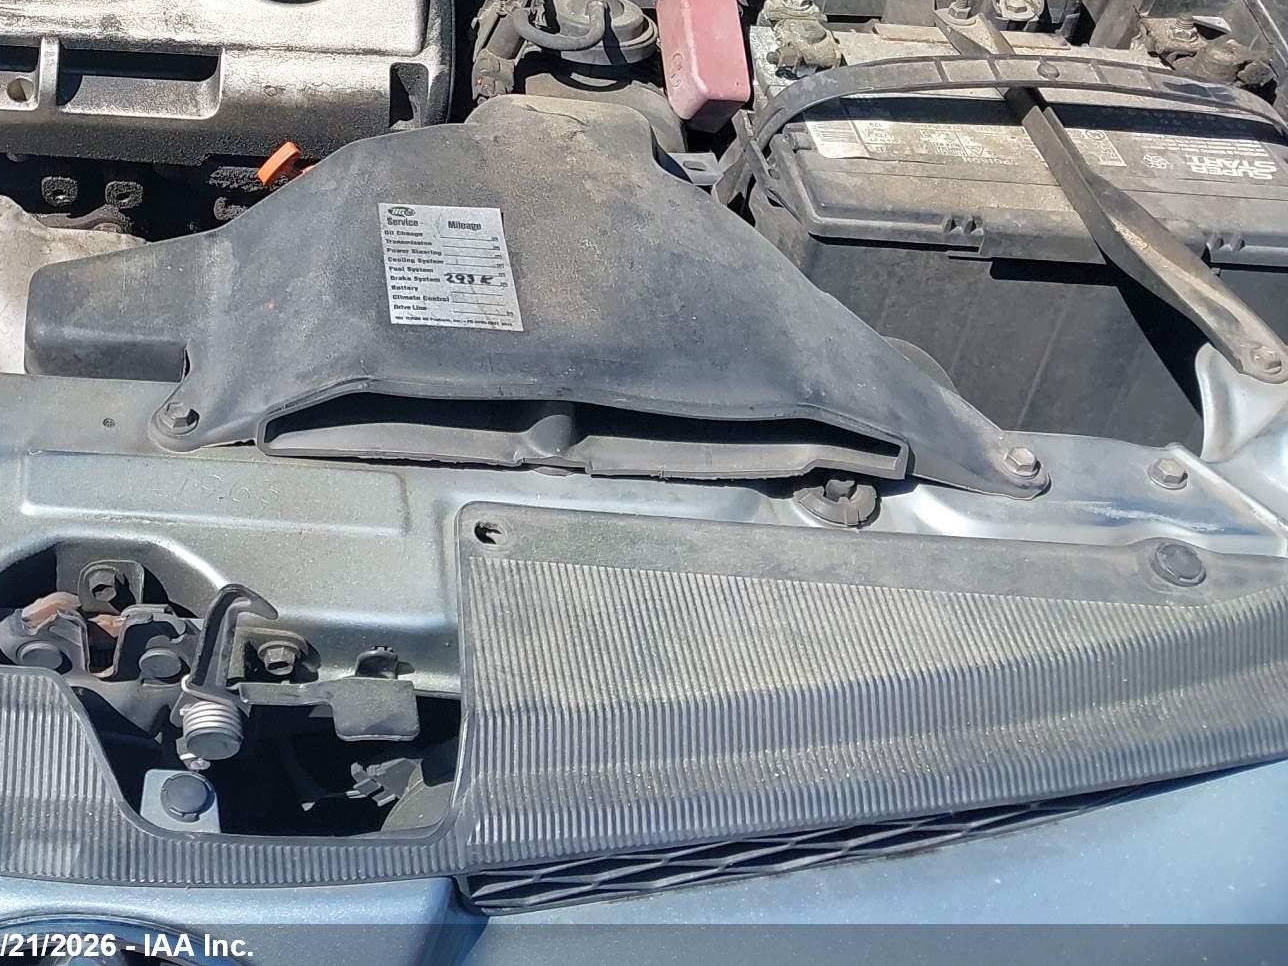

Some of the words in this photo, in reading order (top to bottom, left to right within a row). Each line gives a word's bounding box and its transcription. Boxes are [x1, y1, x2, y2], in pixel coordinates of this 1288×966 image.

[1186, 154, 1277, 173] START
[1191, 166, 1273, 180] SUPER
[387, 217, 419, 227] Service
[448, 220, 482, 231] Mileage
[411, 248, 442, 256] Steering
[444, 273, 475, 285] 293
[423, 295, 450, 303] Control
